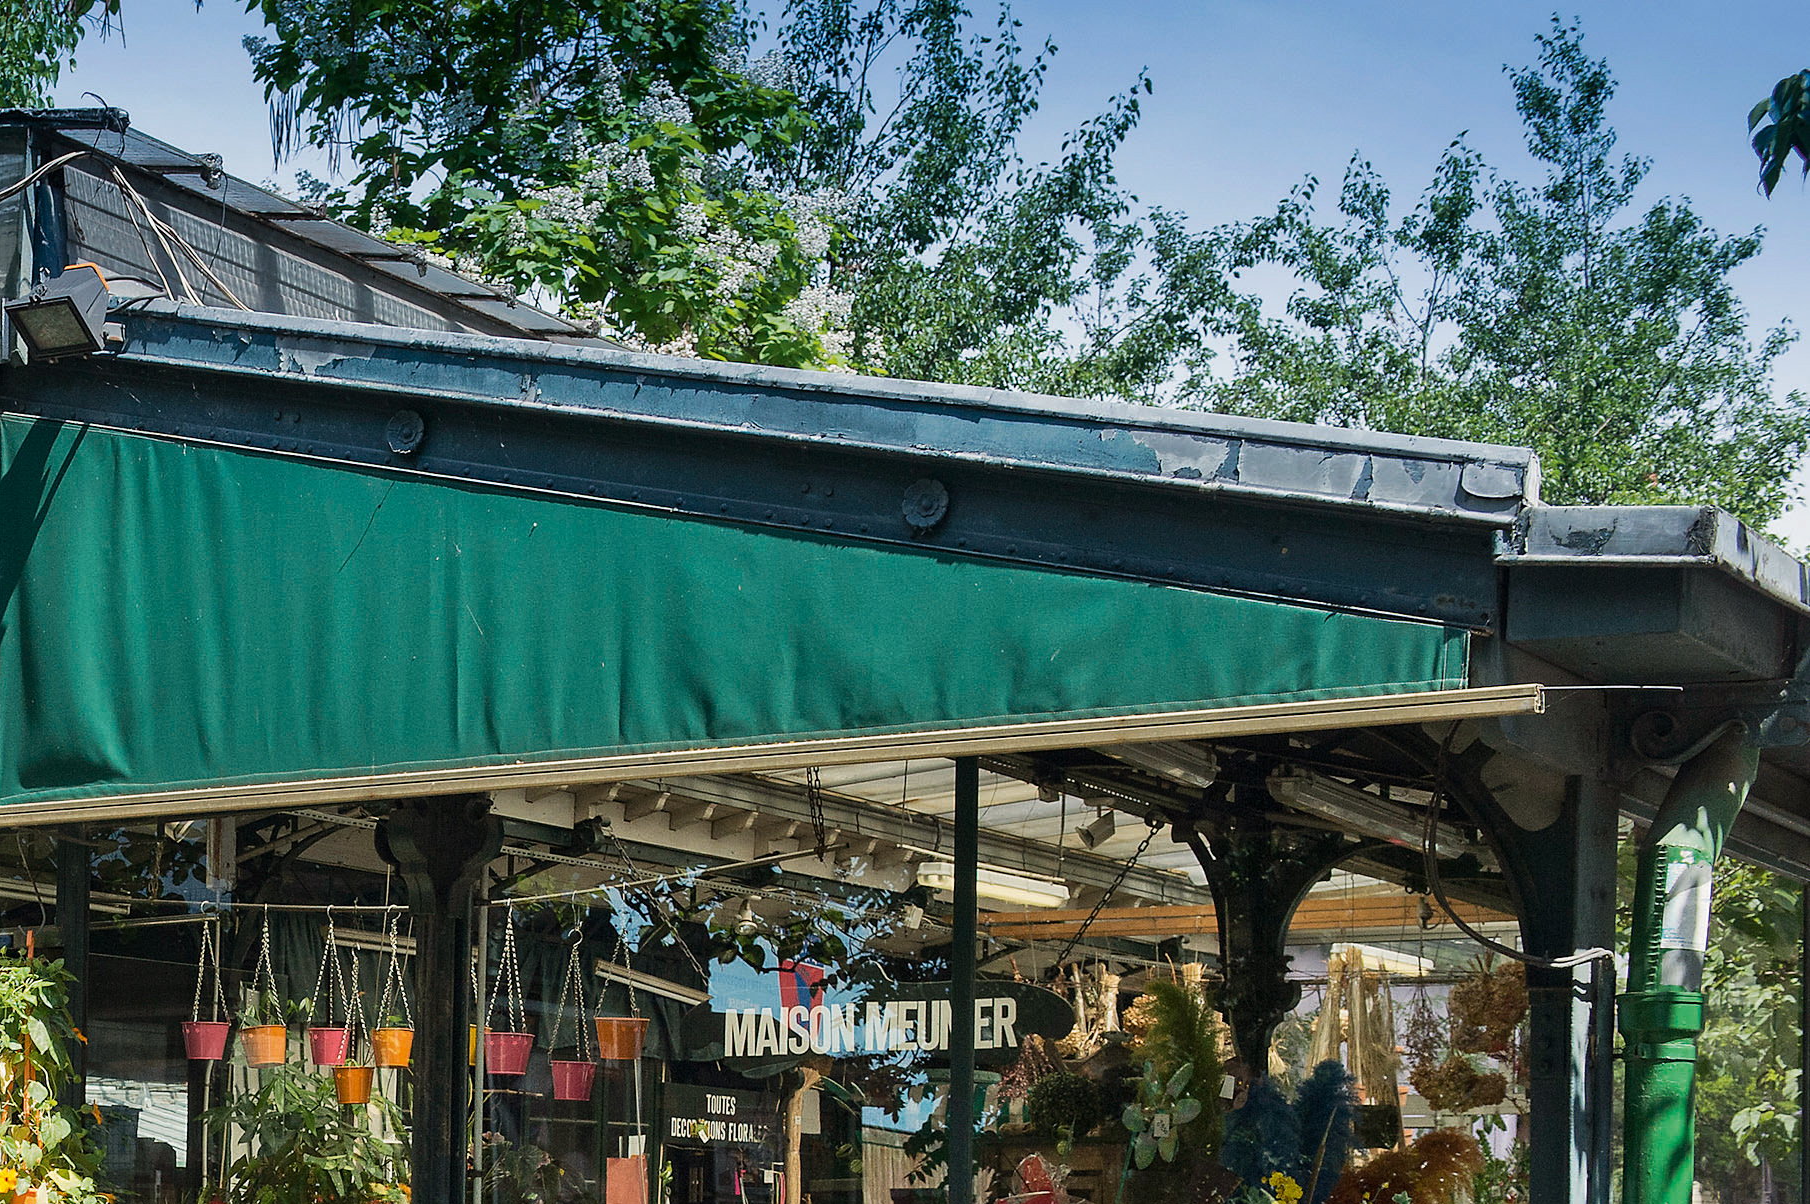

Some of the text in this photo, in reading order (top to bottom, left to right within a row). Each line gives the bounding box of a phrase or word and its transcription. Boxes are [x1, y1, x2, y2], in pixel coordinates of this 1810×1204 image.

[724, 996, 1018, 1057] MAISON MEUNER
[706, 1094, 736, 1116] TOUTES
[728, 1122, 765, 1143] FLORA
